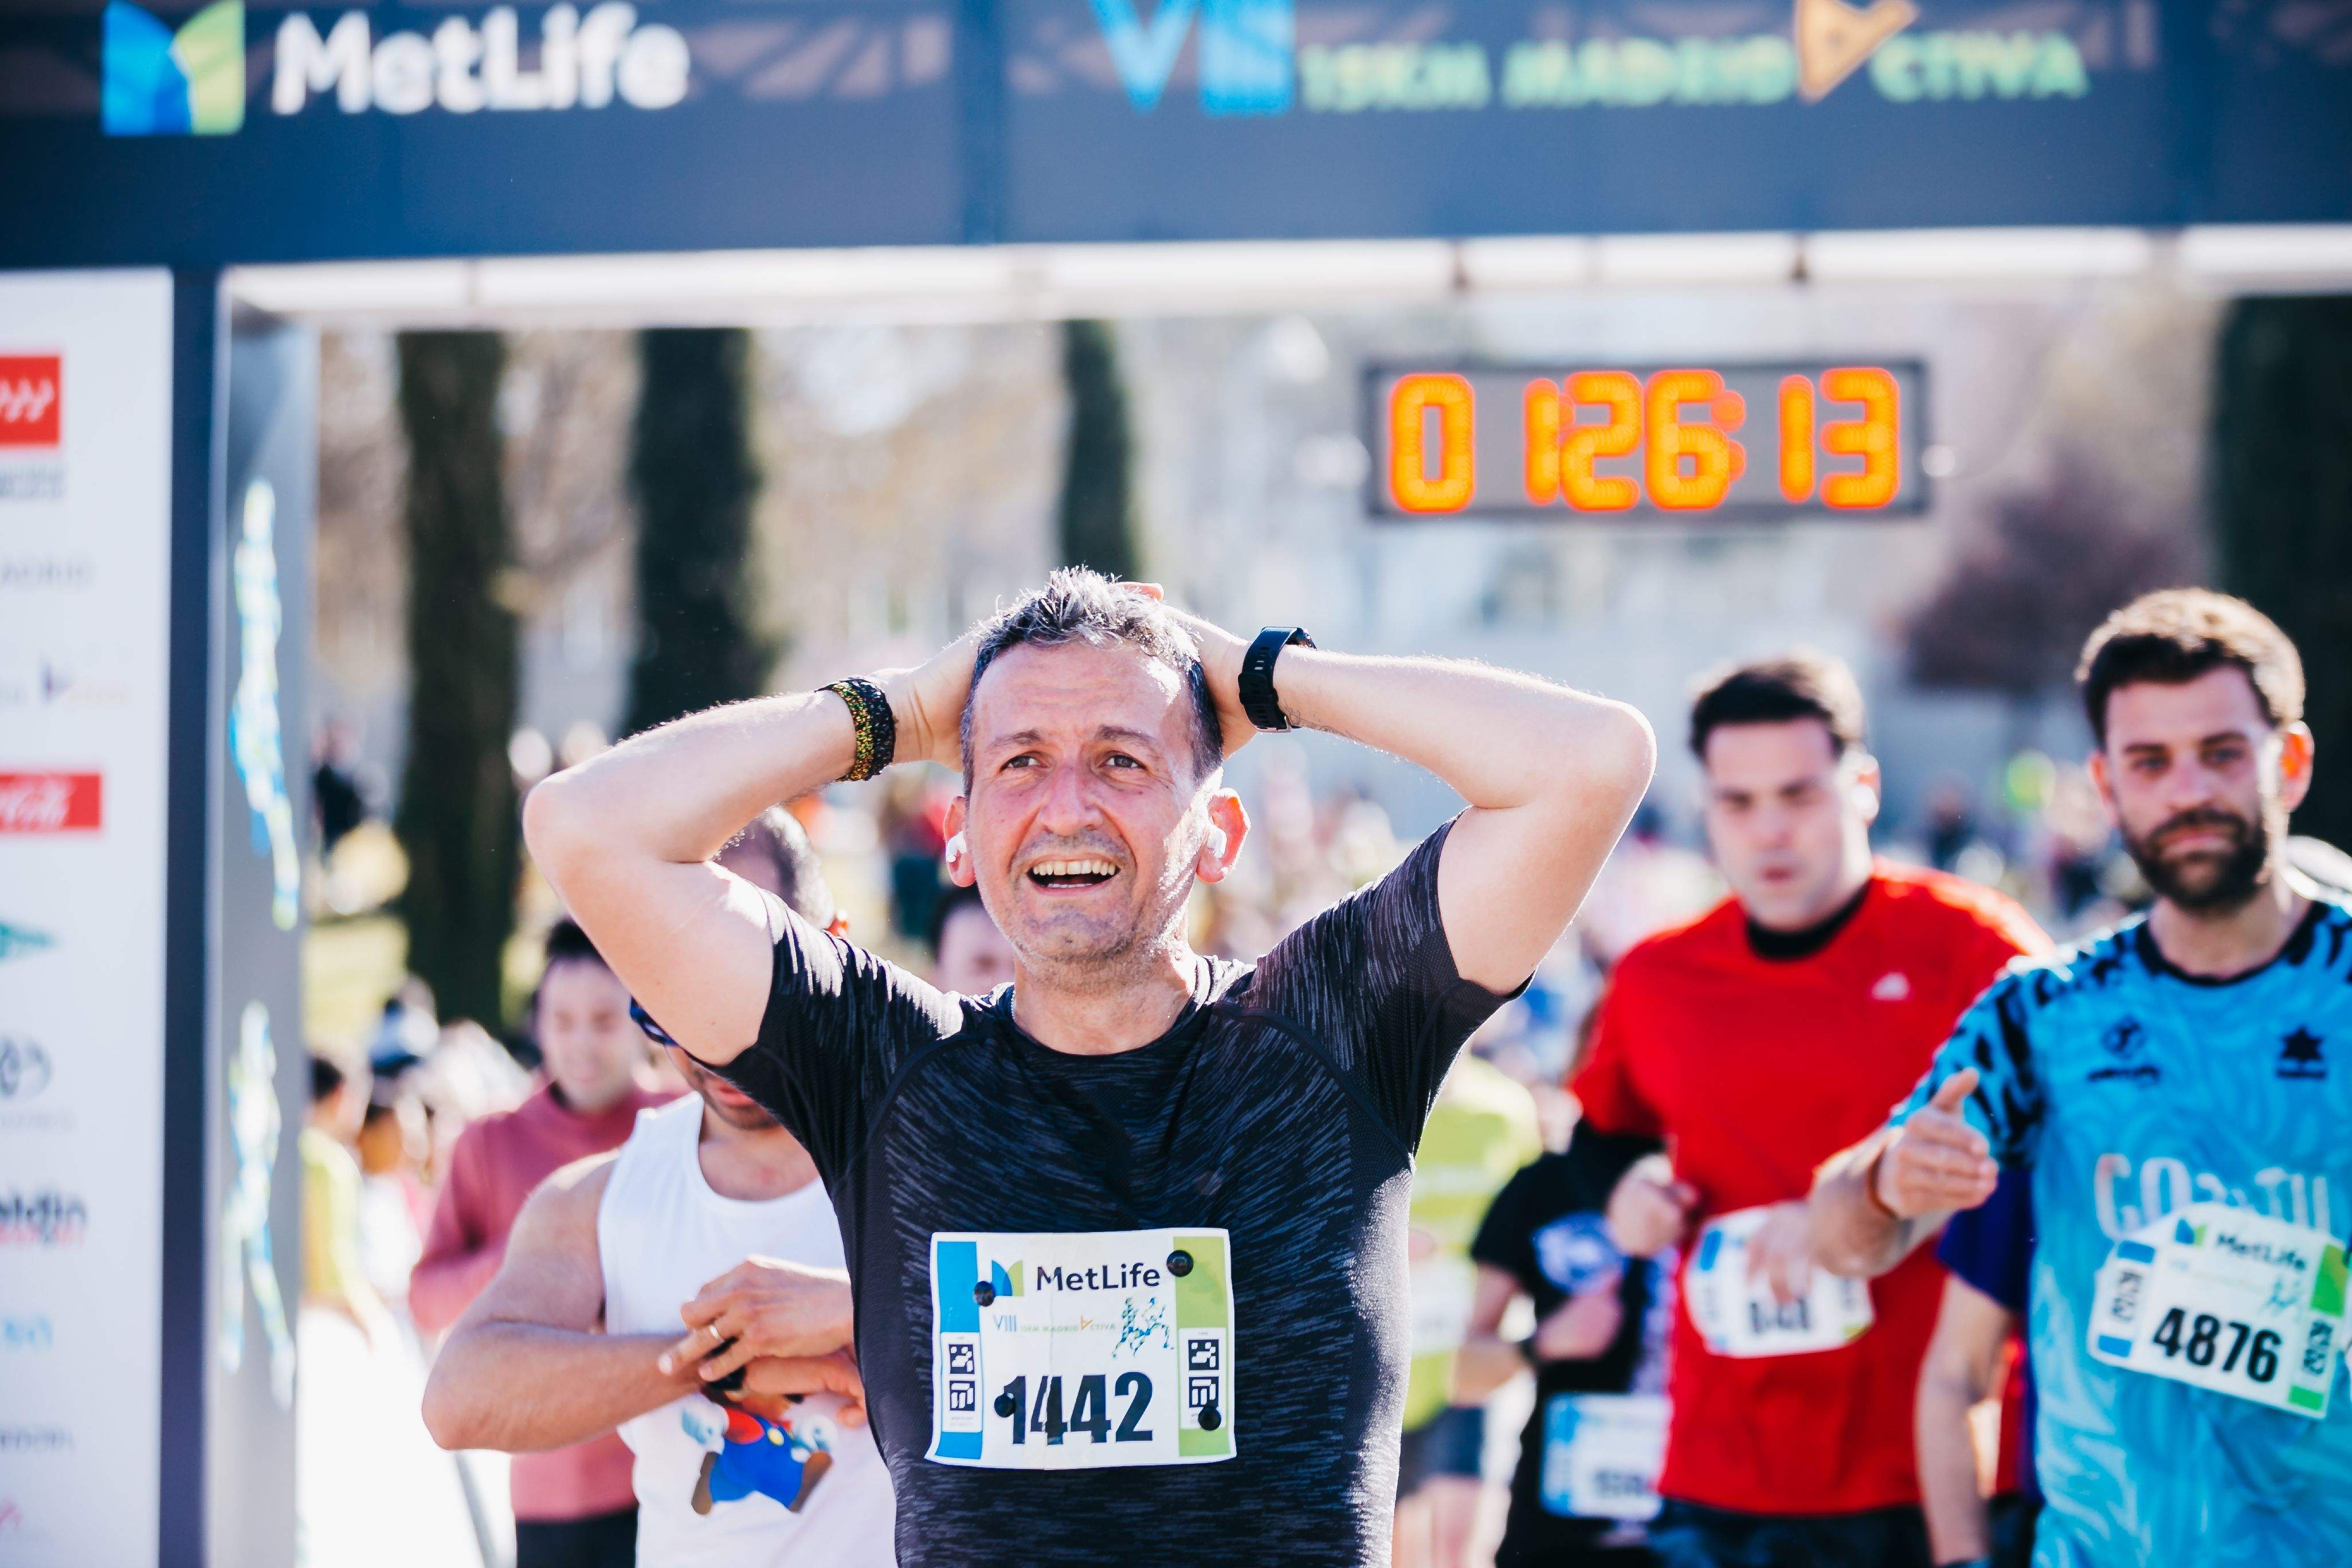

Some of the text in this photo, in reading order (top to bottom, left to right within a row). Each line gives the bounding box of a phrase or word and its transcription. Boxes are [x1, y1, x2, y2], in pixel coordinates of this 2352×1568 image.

[271, 2, 691, 115] MetLife
[1036, 1263, 1161, 1292] MetLife
[993, 1315, 1017, 1332] VIII
[2152, 1307, 2283, 1383] 4876
[1003, 1371, 1153, 1445] 1442
